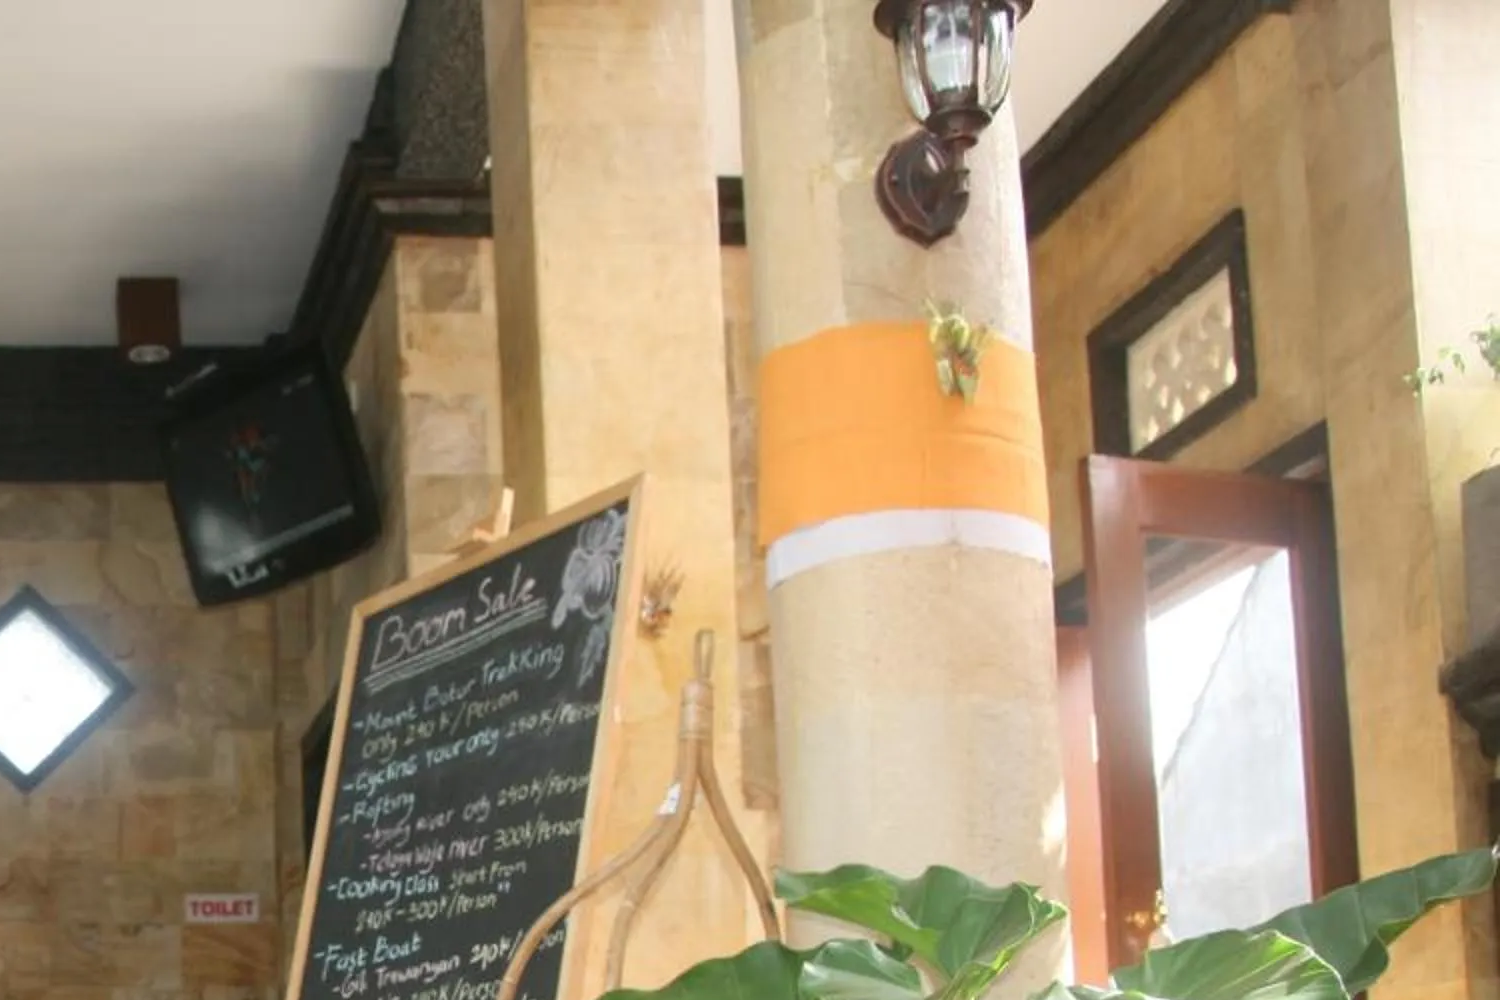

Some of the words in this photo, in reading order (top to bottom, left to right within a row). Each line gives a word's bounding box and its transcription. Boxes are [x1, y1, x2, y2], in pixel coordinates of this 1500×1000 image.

[371, 605, 466, 670] Boom
[474, 562, 537, 623] Sale
[190, 900, 253, 917] TOILET
[372, 931, 422, 964] Boat
